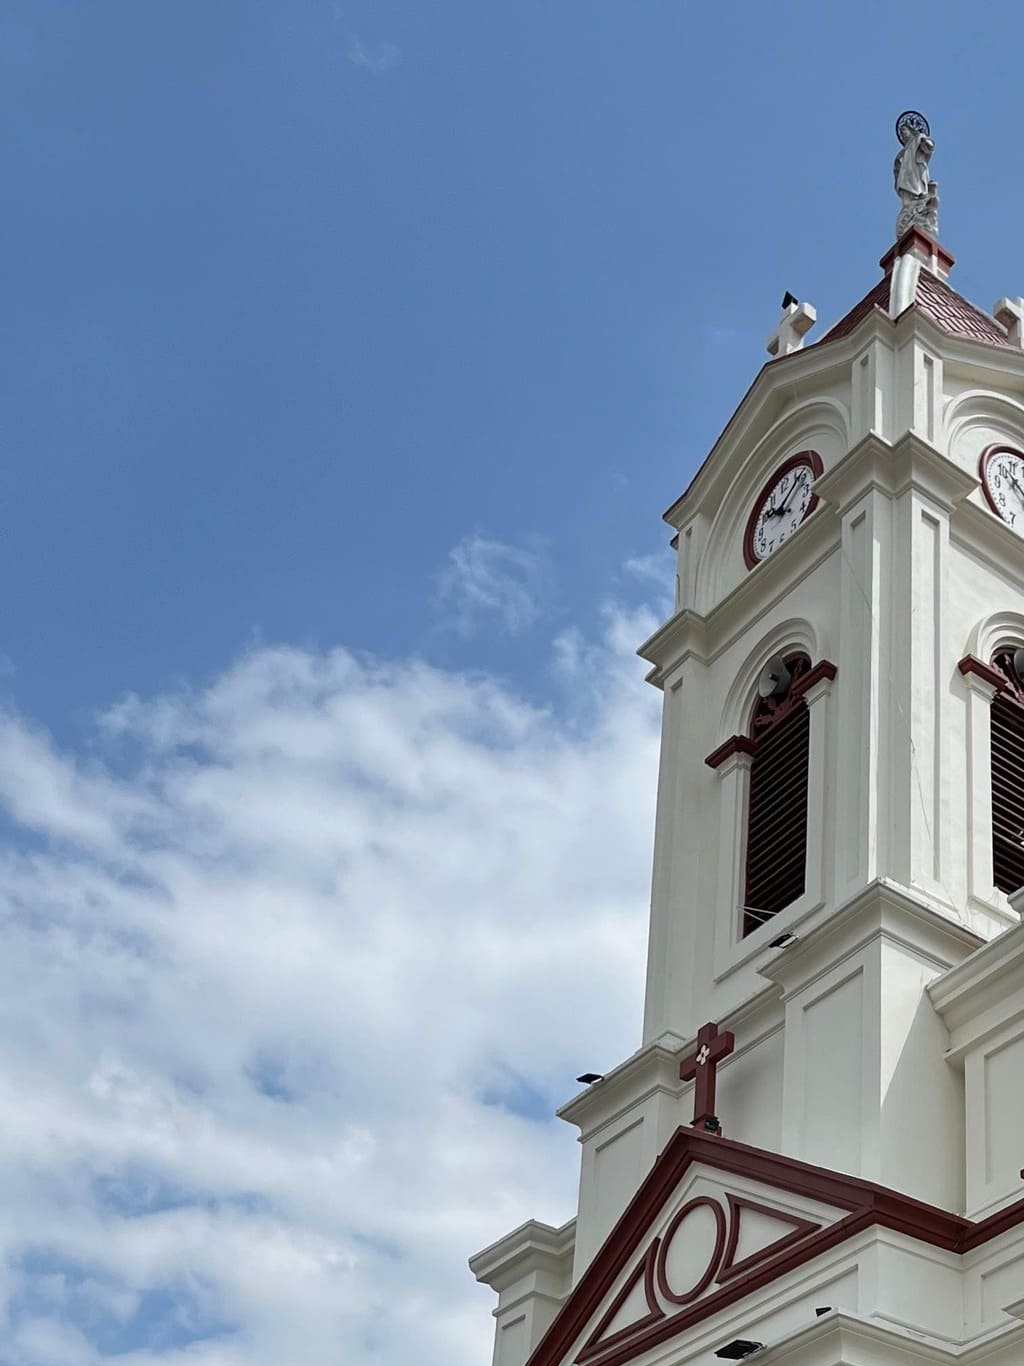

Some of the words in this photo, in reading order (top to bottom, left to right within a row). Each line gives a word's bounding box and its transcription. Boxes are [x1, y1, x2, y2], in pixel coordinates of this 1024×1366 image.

[998, 463, 1008, 479] 10
[1008, 461, 1017, 475] 11
[780, 477, 789, 494] 12
[994, 475, 1001, 488] 9
[802, 483, 809, 498] 3
[769, 495, 776, 507] 11
[800, 500, 806, 513] 4
[998, 492, 1006, 507] 8
[790, 519, 797, 533] 5
[1009, 512, 1016, 528] 7
[758, 527, 764, 541] 9
[760, 537, 767, 552] 8
[768, 539, 775, 552] 7
